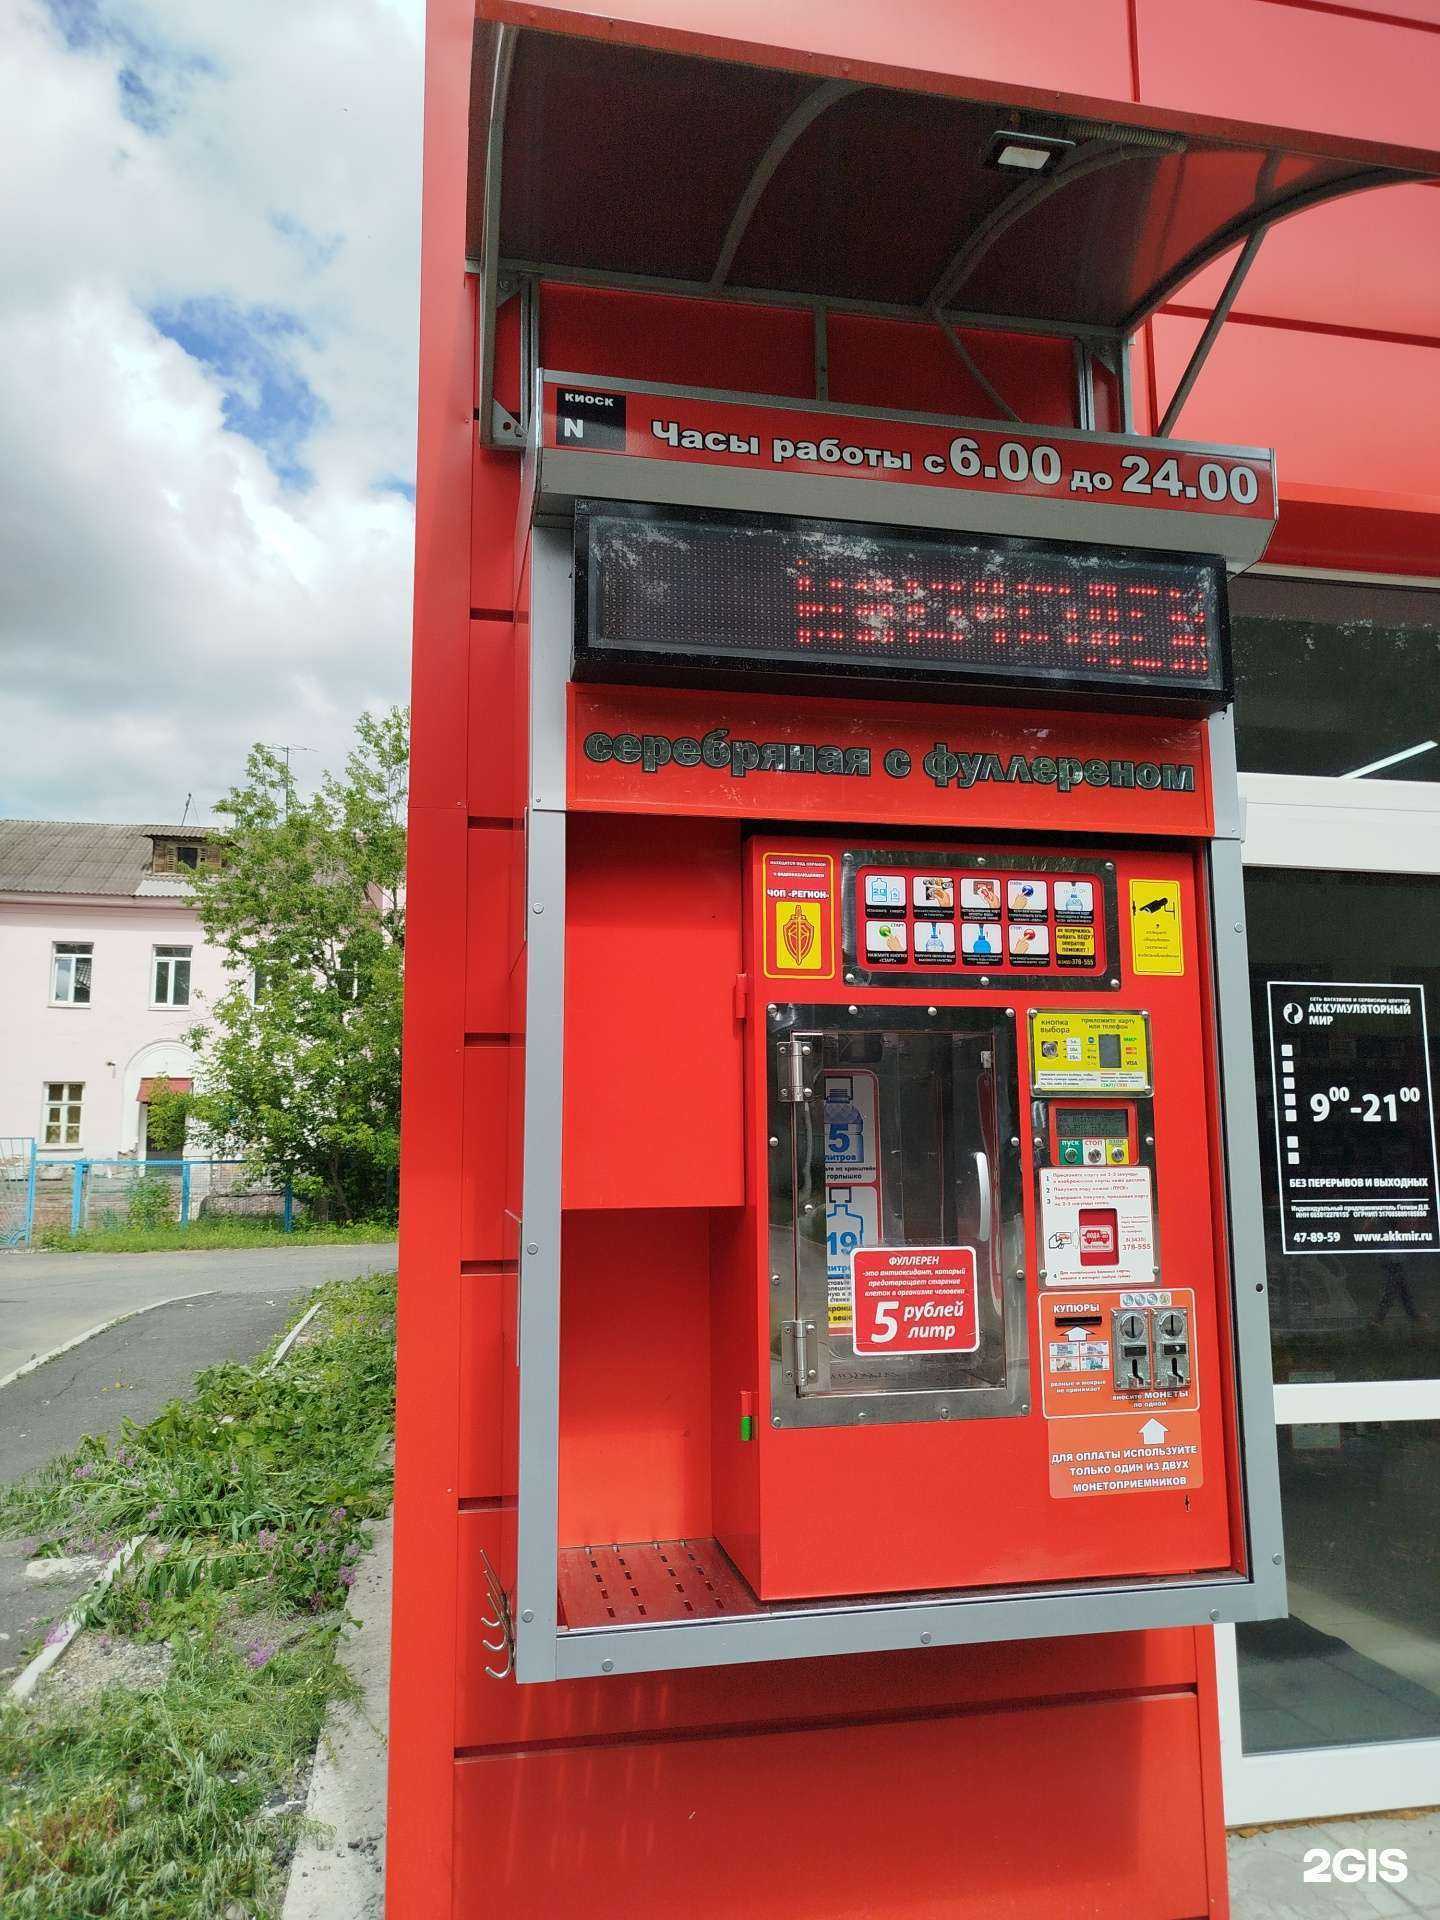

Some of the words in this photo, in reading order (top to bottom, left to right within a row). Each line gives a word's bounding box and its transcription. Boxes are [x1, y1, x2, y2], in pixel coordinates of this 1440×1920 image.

[563, 417, 584, 439] N
[651, 419, 760, 455] Часы
[772, 438, 913, 471] работы
[1071, 470, 1113, 493] до
[1122, 455, 1258, 504] 24.00
[583, 728, 872, 778] серебряная
[883, 746, 912, 778] с
[923, 743, 1195, 793] фуллереном
[767, 889, 786, 898] ЧОП
[1308, 1003, 1411, 1015] АККУМУЛЯТОРНЫЙ
[1308, 1016, 1334, 1025] МИР
[1040, 1026, 1070, 1034] выбора
[828, 1123, 850, 1153] 5
[1289, 1179, 1307, 1188] БЕЗ
[1308, 1178, 1364, 1188] ПЕРЕРЫВОВ
[1365, 1178, 1372, 1187] И
[1373, 1178, 1428, 1189] ВЫХОДНЫХ
[1293, 1232, 1340, 1242] 47-89-59
[1353, 1231, 1433, 1242] www.akkmir.ru
[889, 1256, 940, 1266] ФУЛЛЕРЕН
[935, 1268, 966, 1276] который
[1053, 1303, 1100, 1314] КУПЮРЫ
[871, 1301, 899, 1343] 5
[903, 1300, 964, 1322] рублей
[907, 1325, 956, 1341] литр
[1143, 1391, 1189, 1399] МОНЕТЫ
[1051, 1453, 1073, 1465] ДЛЯ
[1076, 1451, 1121, 1461] ОПЛАТЫ
[1070, 1467, 1111, 1476] ТОЛЬКО
[1114, 1463, 1143, 1474] ОДИН
[1146, 1462, 1160, 1471] ИЗ
[1162, 1460, 1189, 1471] ДВУХ
[1073, 1477, 1187, 1492] МОНЕТОПРИЕМНИКОВ
